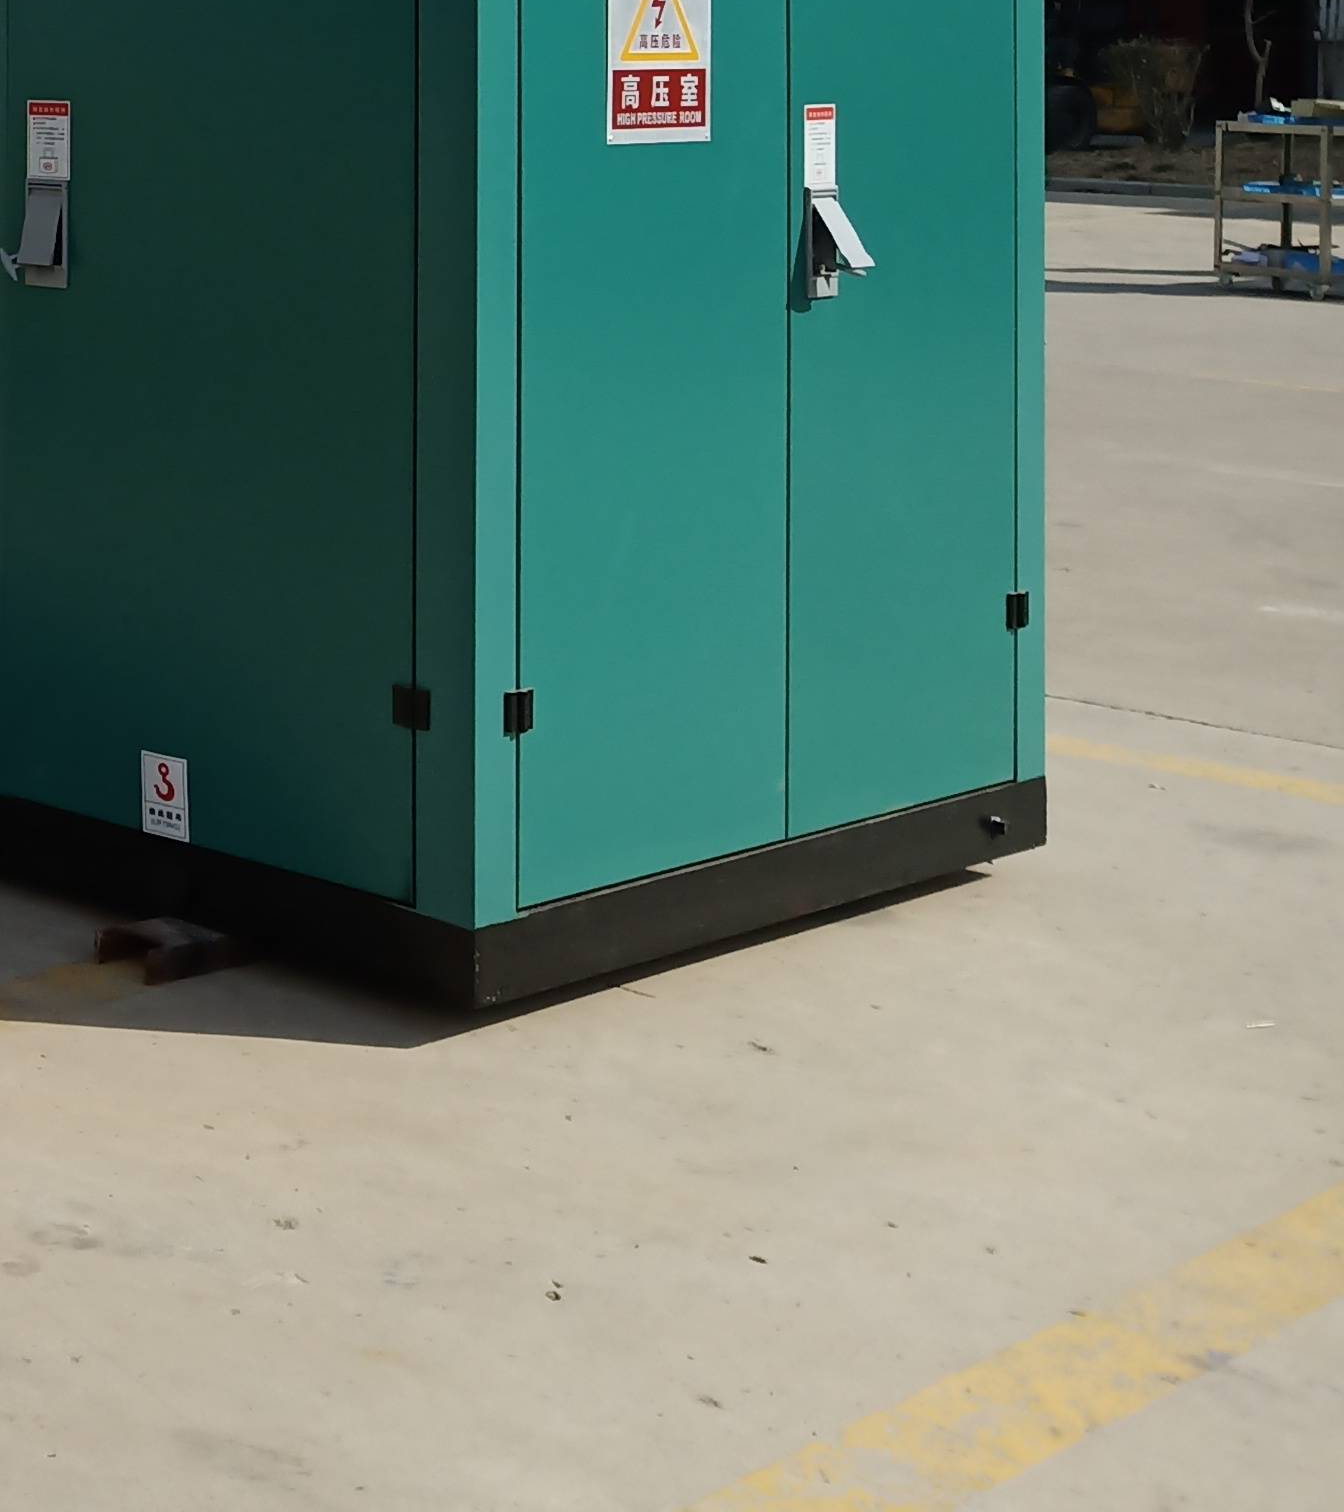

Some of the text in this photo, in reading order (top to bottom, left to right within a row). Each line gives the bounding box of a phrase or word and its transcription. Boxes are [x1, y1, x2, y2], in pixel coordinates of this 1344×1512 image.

[639, 34, 681, 49] 高压危险
[620, 73, 699, 109] 高压室
[616, 110, 702, 126] HIGH PRESSURE ROOM
